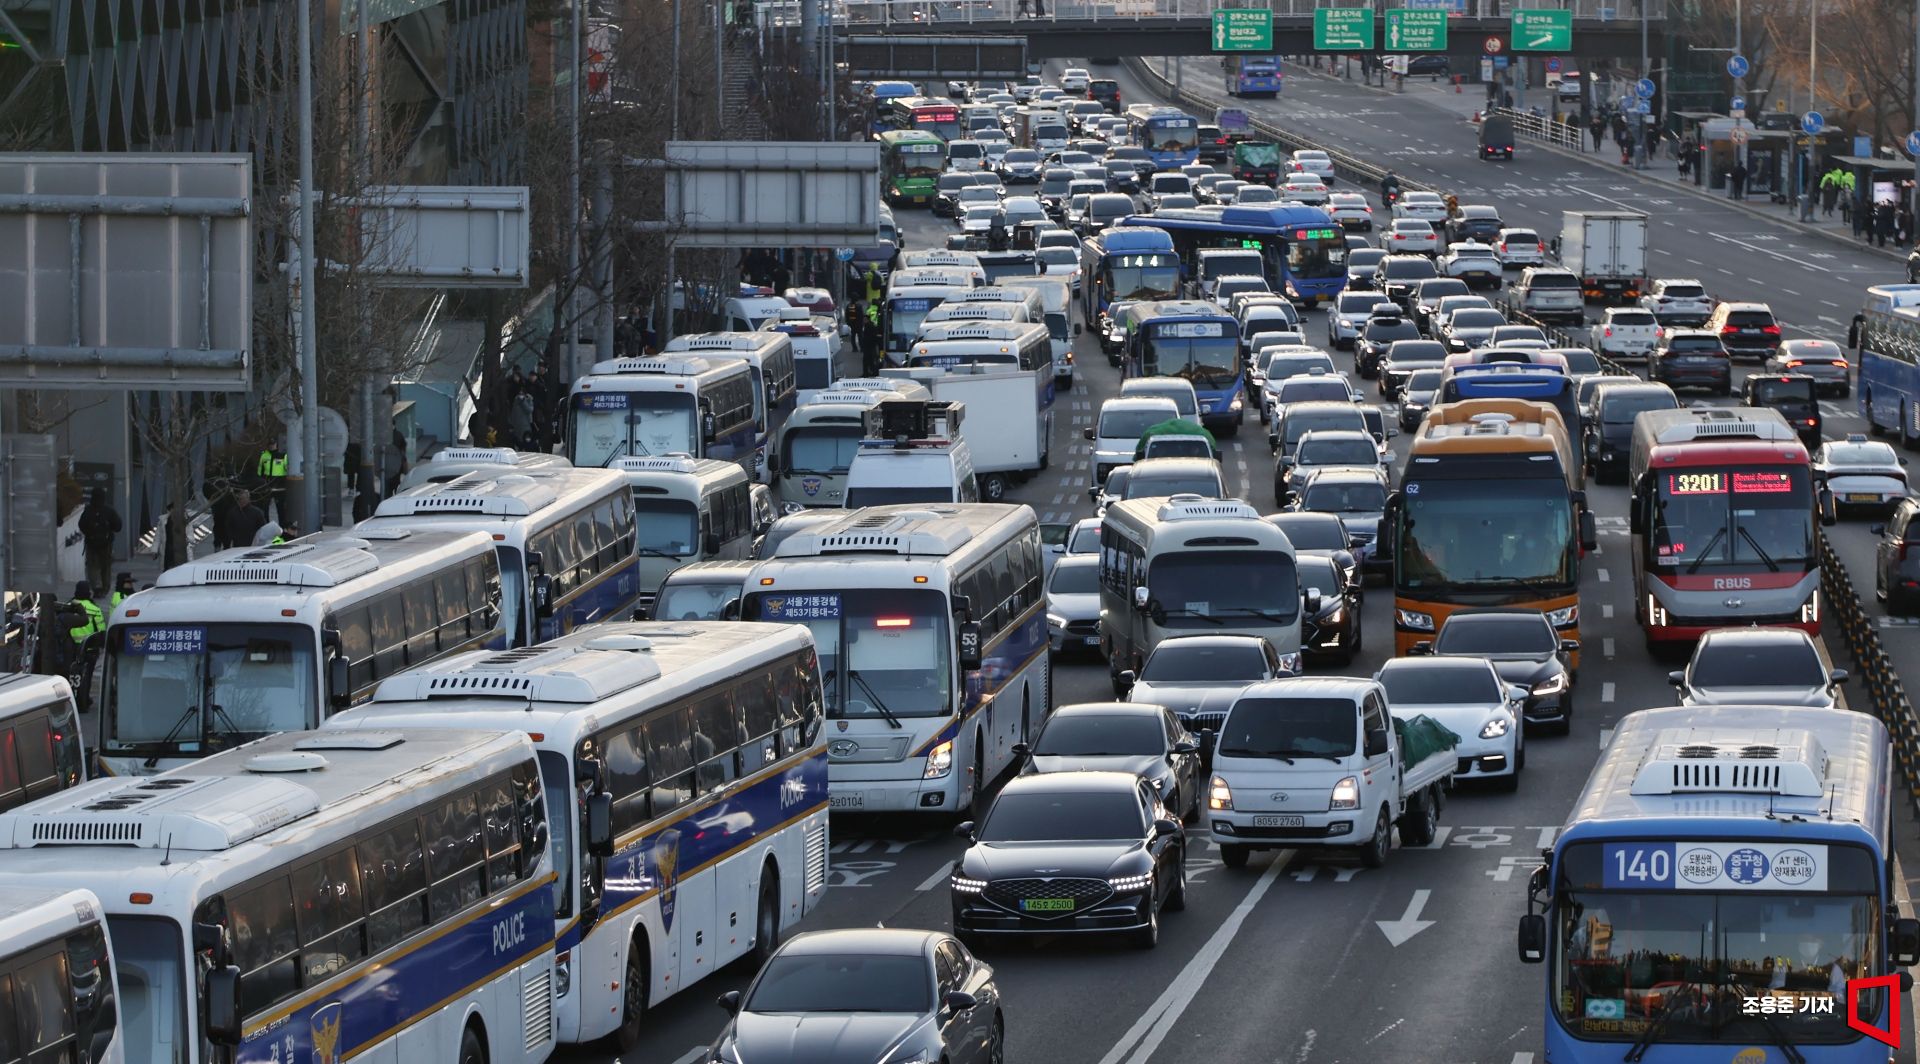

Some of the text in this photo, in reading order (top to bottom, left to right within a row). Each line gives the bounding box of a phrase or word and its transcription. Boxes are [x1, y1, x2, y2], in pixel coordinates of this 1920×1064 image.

[1122, 255, 1158, 267] 144
[1158, 325, 1177, 337] 144
[1678, 473, 1719, 491] 3201
[1406, 484, 1419, 493] G2
[786, 597, 838, 607] 서울기동경찰
[785, 608, 839, 617] 제53기동대-2
[149, 630, 201, 641] 서울기동경찰
[961, 633, 978, 646] 53
[148, 642, 202, 652] 제53기동대-1
[780, 776, 804, 810] POLICE
[1279, 817, 1301, 826] 2760
[1689, 854, 1712, 865] 도봉산역
[1730, 854, 1763, 867] 중구청
[1780, 856, 1808, 866] AT 센터
[1615, 849, 1670, 882] 140
[1683, 865, 1718, 877] 광역환승센터
[1774, 867, 1812, 878] 양재꽃시장
[1050, 900, 1073, 909] 2500
[493, 911, 525, 956] POLICE
